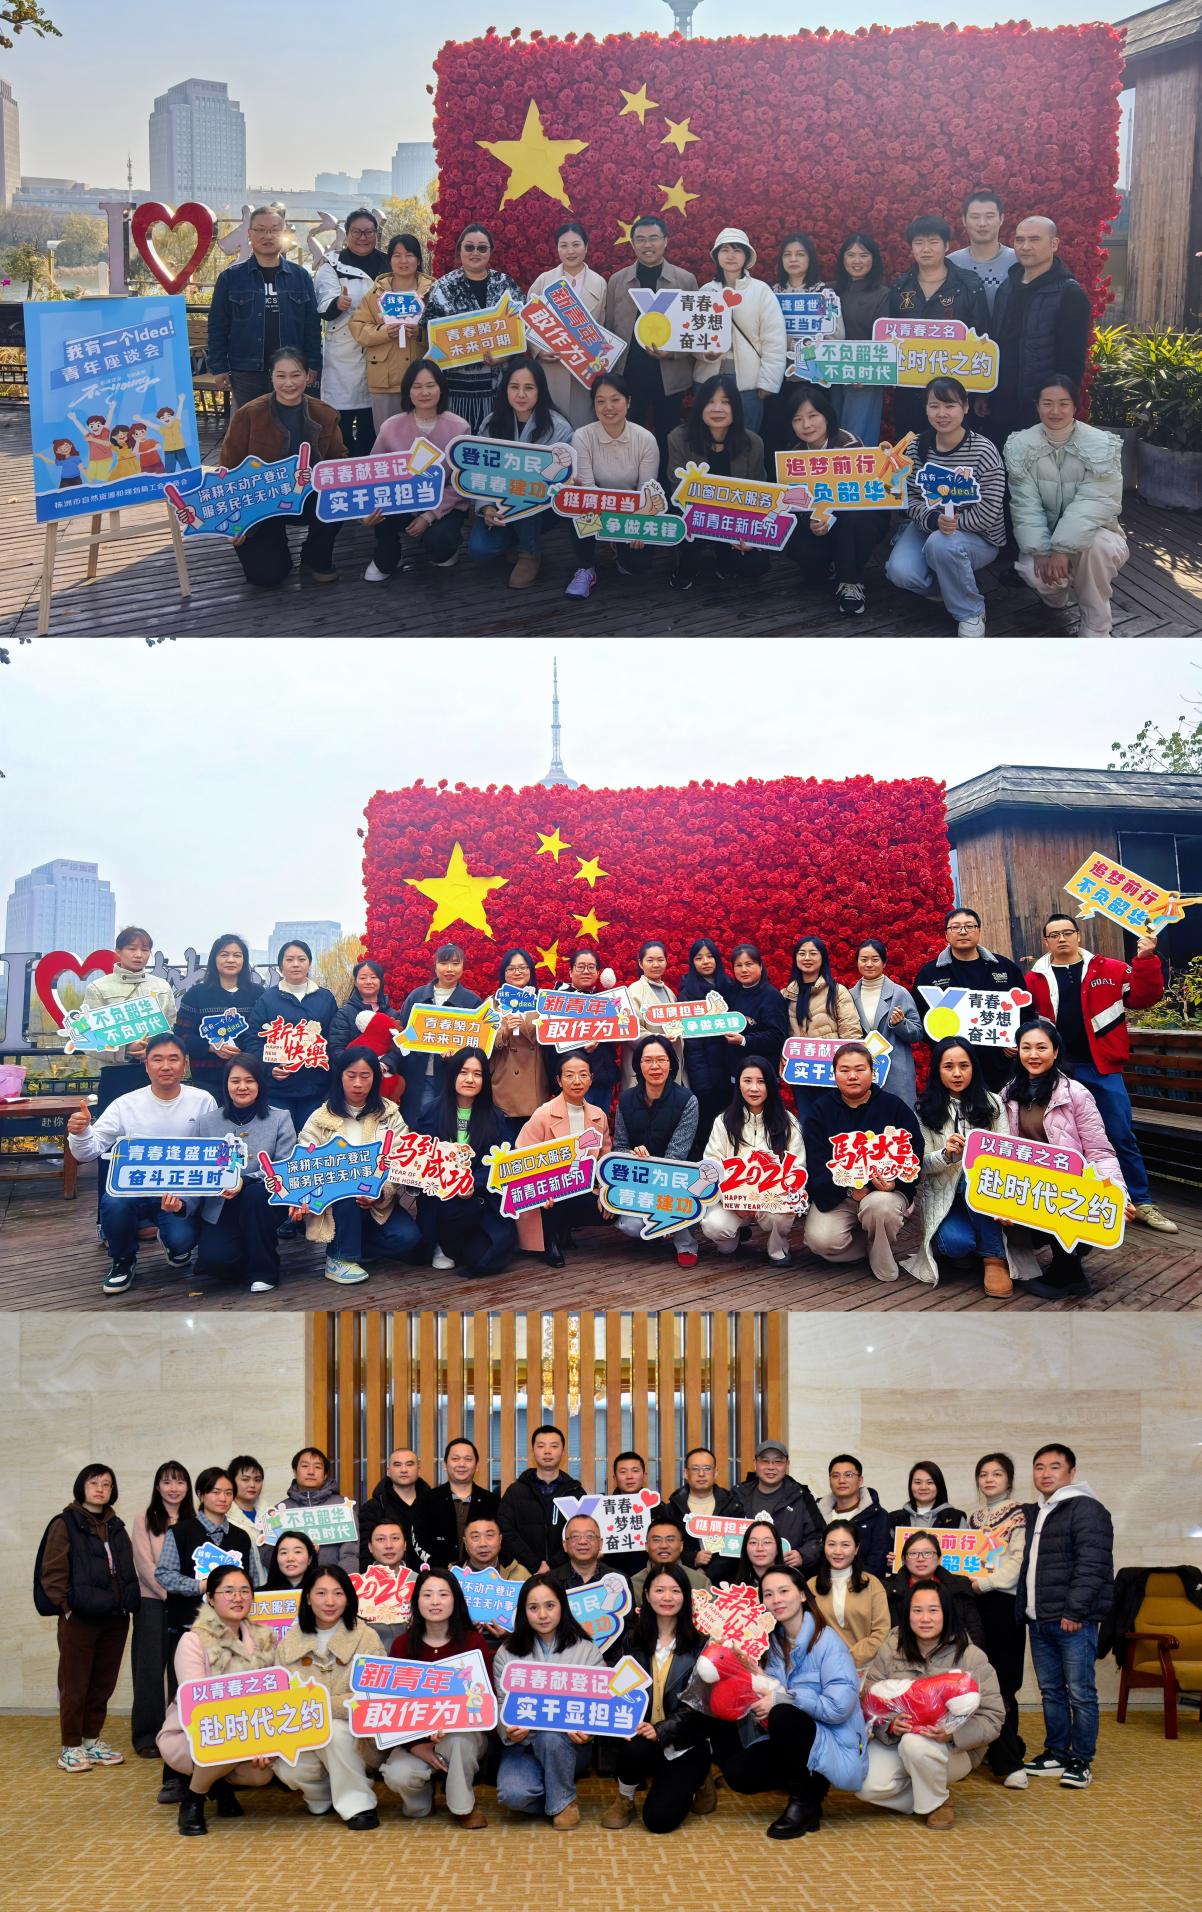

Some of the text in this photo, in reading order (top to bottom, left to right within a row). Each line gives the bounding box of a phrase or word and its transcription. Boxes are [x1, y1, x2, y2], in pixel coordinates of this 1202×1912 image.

[680, 295, 711, 312] 青春
[550, 287, 604, 346] 新青年
[691, 314, 723, 331] 梦想
[446, 319, 507, 342] 青春聚力
[528, 309, 588, 366] 敢作为
[680, 333, 711, 350] 奋斗
[885, 323, 956, 339] 以青春之名
[62, 343, 160, 382] 青年座谈会
[822, 344, 889, 362] 不负韶华
[825, 364, 891, 380] 不负时代
[319, 458, 408, 485] 青春献登记
[461, 447, 542, 473] 登记为民
[786, 454, 875, 477] 追梦前行
[199, 467, 289, 503] 深耕不动产登记
[329, 481, 436, 512] 实干显担当
[470, 472, 546, 499] 青春建功
[688, 481, 773, 508] 小窗口大服务
[790, 480, 886, 503] 负韶华
[202, 483, 292, 519] 服务民生无小事
[563, 491, 635, 513] 挺膺担当
[606, 517, 678, 538] 争做先锋
[691, 510, 778, 538] 新青年新作为
[1089, 861, 1159, 906] 追梦前行
[1076, 876, 1149, 926] 不负韶华
[543, 995, 609, 1015] 新青年
[652, 1005, 707, 1019] 挺膺担当
[968, 993, 1000, 1010] 青春
[94, 999, 158, 1029] 不负韶华
[425, 1017, 481, 1034] 青春聚力
[686, 1016, 741, 1032] 争做先锋
[979, 1010, 1011, 1027] 梦想
[106, 1017, 164, 1042] 不负时代
[422, 1032, 480, 1048] 未来可期
[546, 1019, 614, 1038] 敢作为
[967, 1027, 1000, 1044] 奋斗
[789, 1042, 840, 1058] 青春献
[128, 1145, 218, 1161] 青春逢盛世
[287, 1150, 371, 1173] 深耕不动产登记
[499, 1144, 573, 1179] 小窗口大服务
[980, 1136, 1071, 1171] 以青春之名
[129, 1170, 223, 1186] 奋斗正当时
[288, 1165, 374, 1190] 服务民生无小事
[391, 1169, 406, 1177] YEAR
[402, 1177, 422, 1187] HORSE
[611, 1163, 688, 1189] 登记为民
[719, 1151, 807, 1193] 2026
[510, 1170, 585, 1203] 新青年新作为
[618, 1189, 693, 1214] 青春建功
[977, 1167, 1118, 1230] 赴时代之约
[286, 1508, 345, 1528] 不负韶华
[602, 1498, 632, 1515] 青春
[301, 1527, 351, 1541] 负时代
[614, 1515, 644, 1532] 梦想
[606, 1535, 635, 1551] 奋斗
[191, 1673, 278, 1701] 以青春之名
[359, 1663, 454, 1693] 新青年
[509, 1668, 609, 1694] 青春献登记
[199, 1699, 324, 1748] 赴时代之约
[362, 1701, 460, 1728] 敢作为
[516, 1697, 634, 1729] 实干显担当
